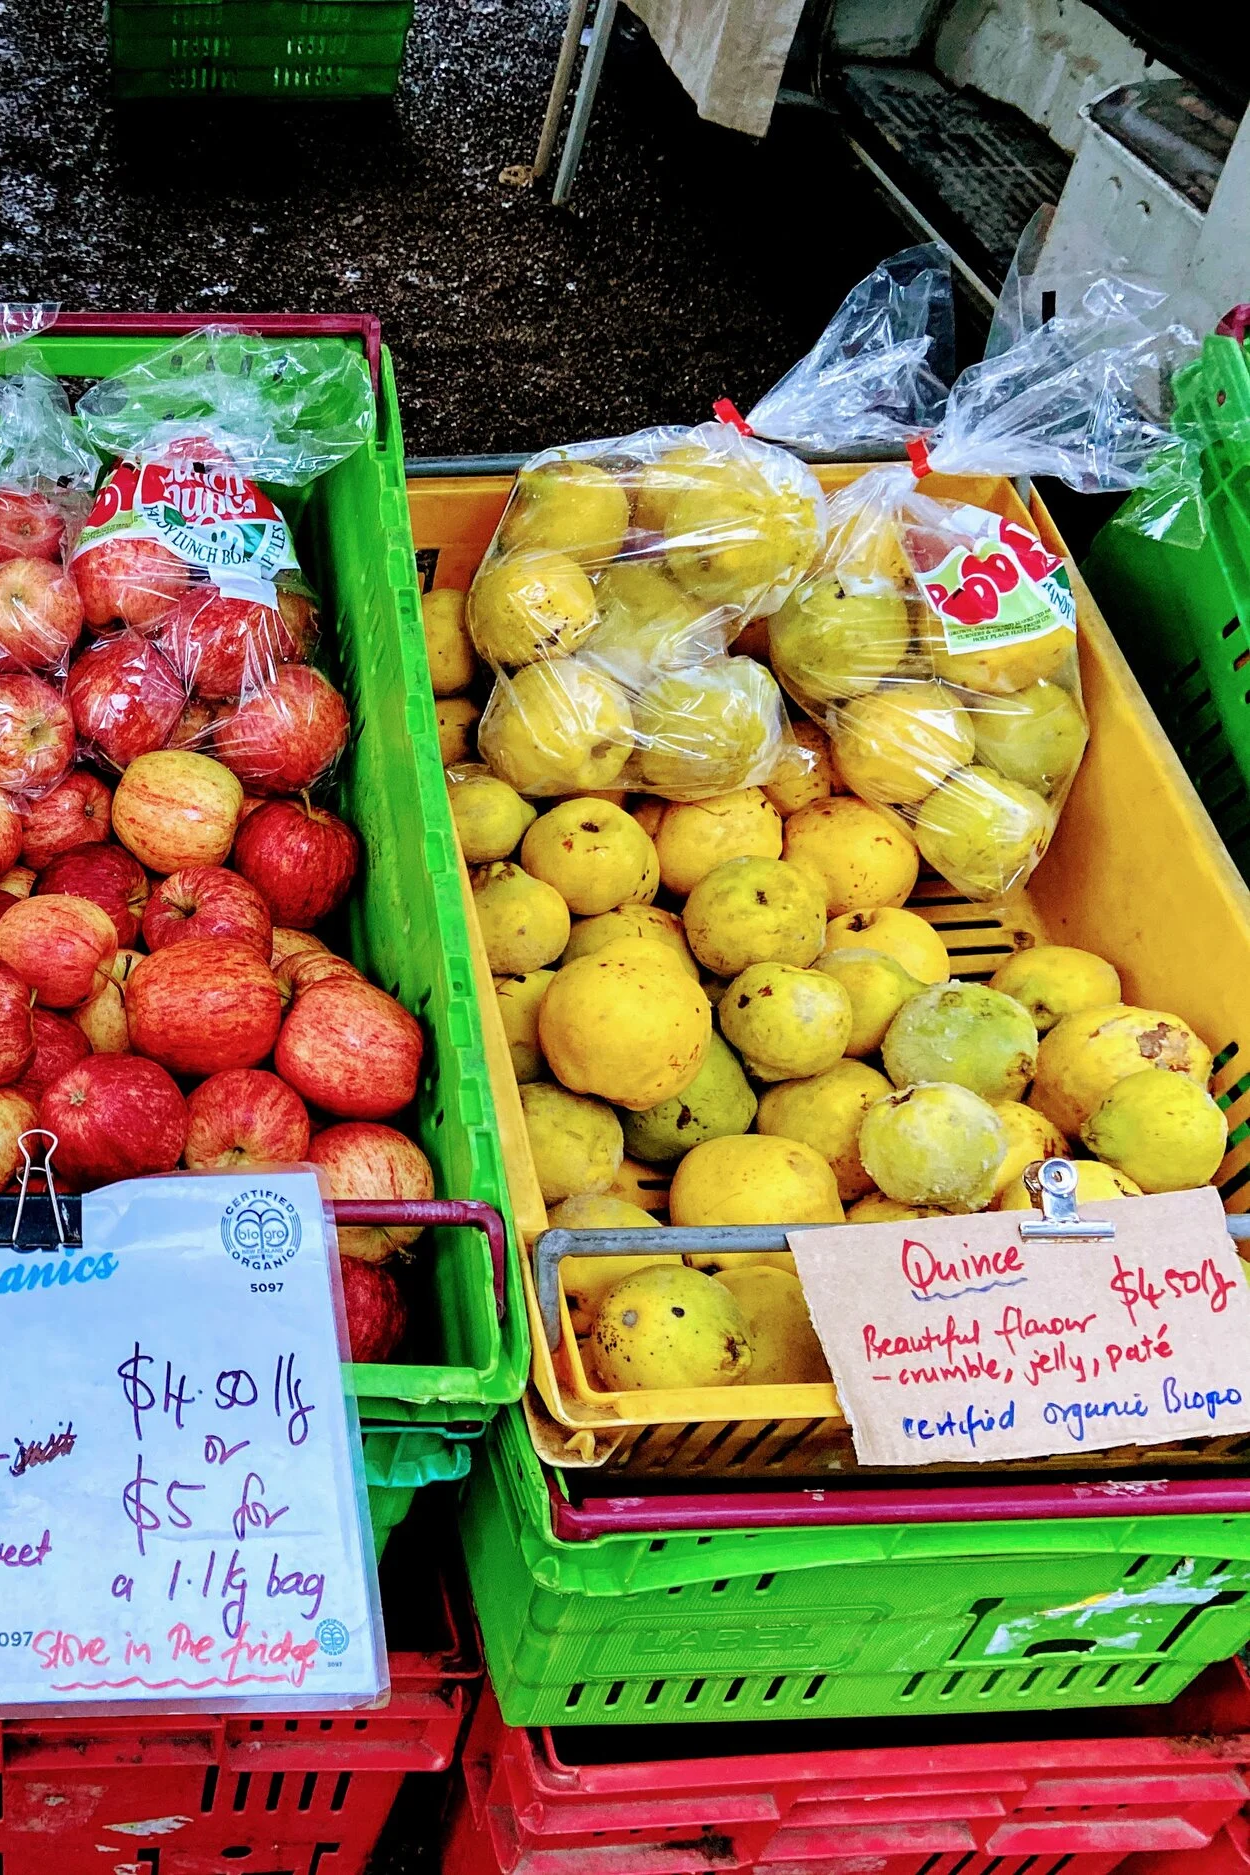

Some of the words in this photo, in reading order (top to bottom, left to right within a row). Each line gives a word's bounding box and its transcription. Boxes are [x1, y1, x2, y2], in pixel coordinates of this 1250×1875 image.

[171, 530, 217, 565] LUNCH
[225, 1189, 295, 1215] CERTIFIED
[232, 1248, 296, 1271] ORGANIC
[901, 1239, 1025, 1297] Quince
[250, 1282, 284, 1293] 5097
[863, 1315, 980, 1363] Beautiful
[995, 1306, 1097, 1356] flavour
[1106, 1323, 1173, 1372] paté
[1044, 1392, 1148, 1441] organic
[204, 1434, 250, 1465] or
[123, 1454, 206, 1556] $5
[232, 1472, 290, 1541] for
[111, 1573, 135, 1602] a
[266, 1552, 325, 1620] bag
[32, 1629, 110, 1669] Store
[125, 1631, 151, 1666] in
[220, 1620, 319, 1687] fridge
[634, 1624, 817, 1655] LABEL
